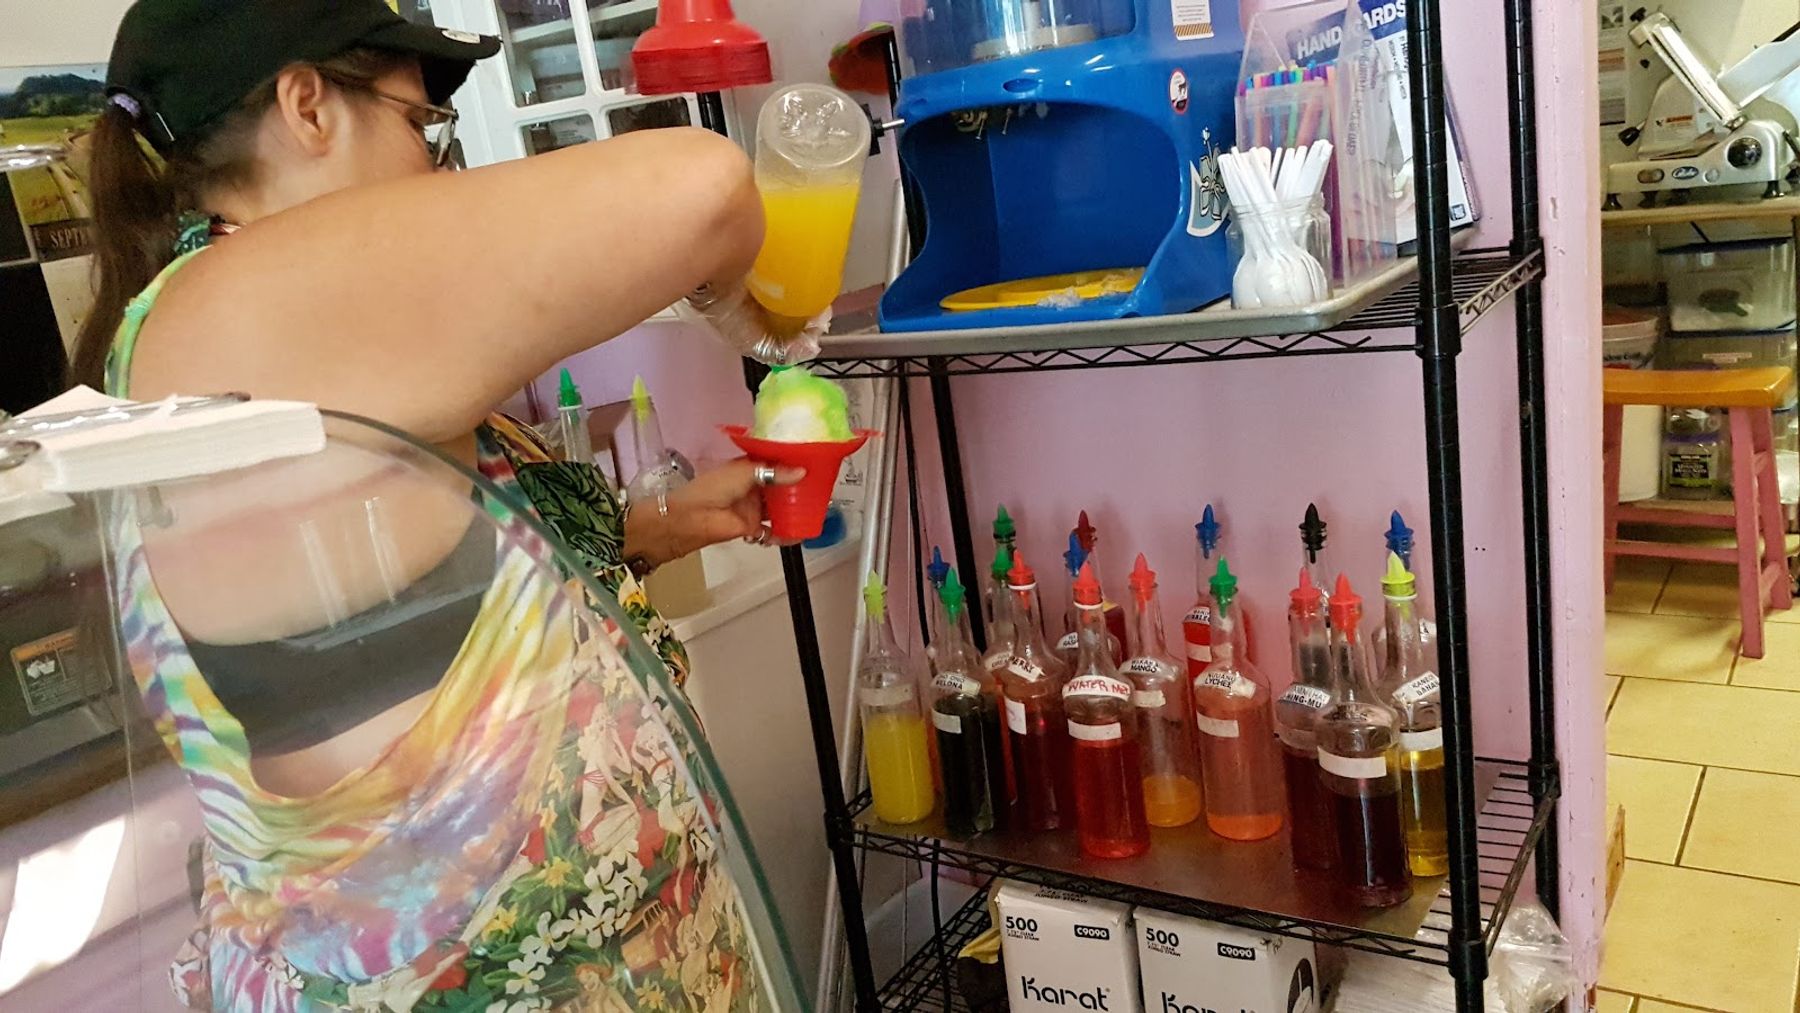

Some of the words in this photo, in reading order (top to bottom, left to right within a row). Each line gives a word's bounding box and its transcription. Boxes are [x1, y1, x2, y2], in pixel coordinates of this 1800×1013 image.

[1296, 26, 1343, 59] HAND
[1131, 665, 1157, 673] MANGO
[1068, 679, 1109, 693] WATER
[1006, 916, 1038, 932] 500
[1076, 926, 1108, 938] C9090
[1146, 928, 1179, 947] 500
[1220, 945, 1253, 958] C9090
[1021, 976, 1108, 1012] Karat
